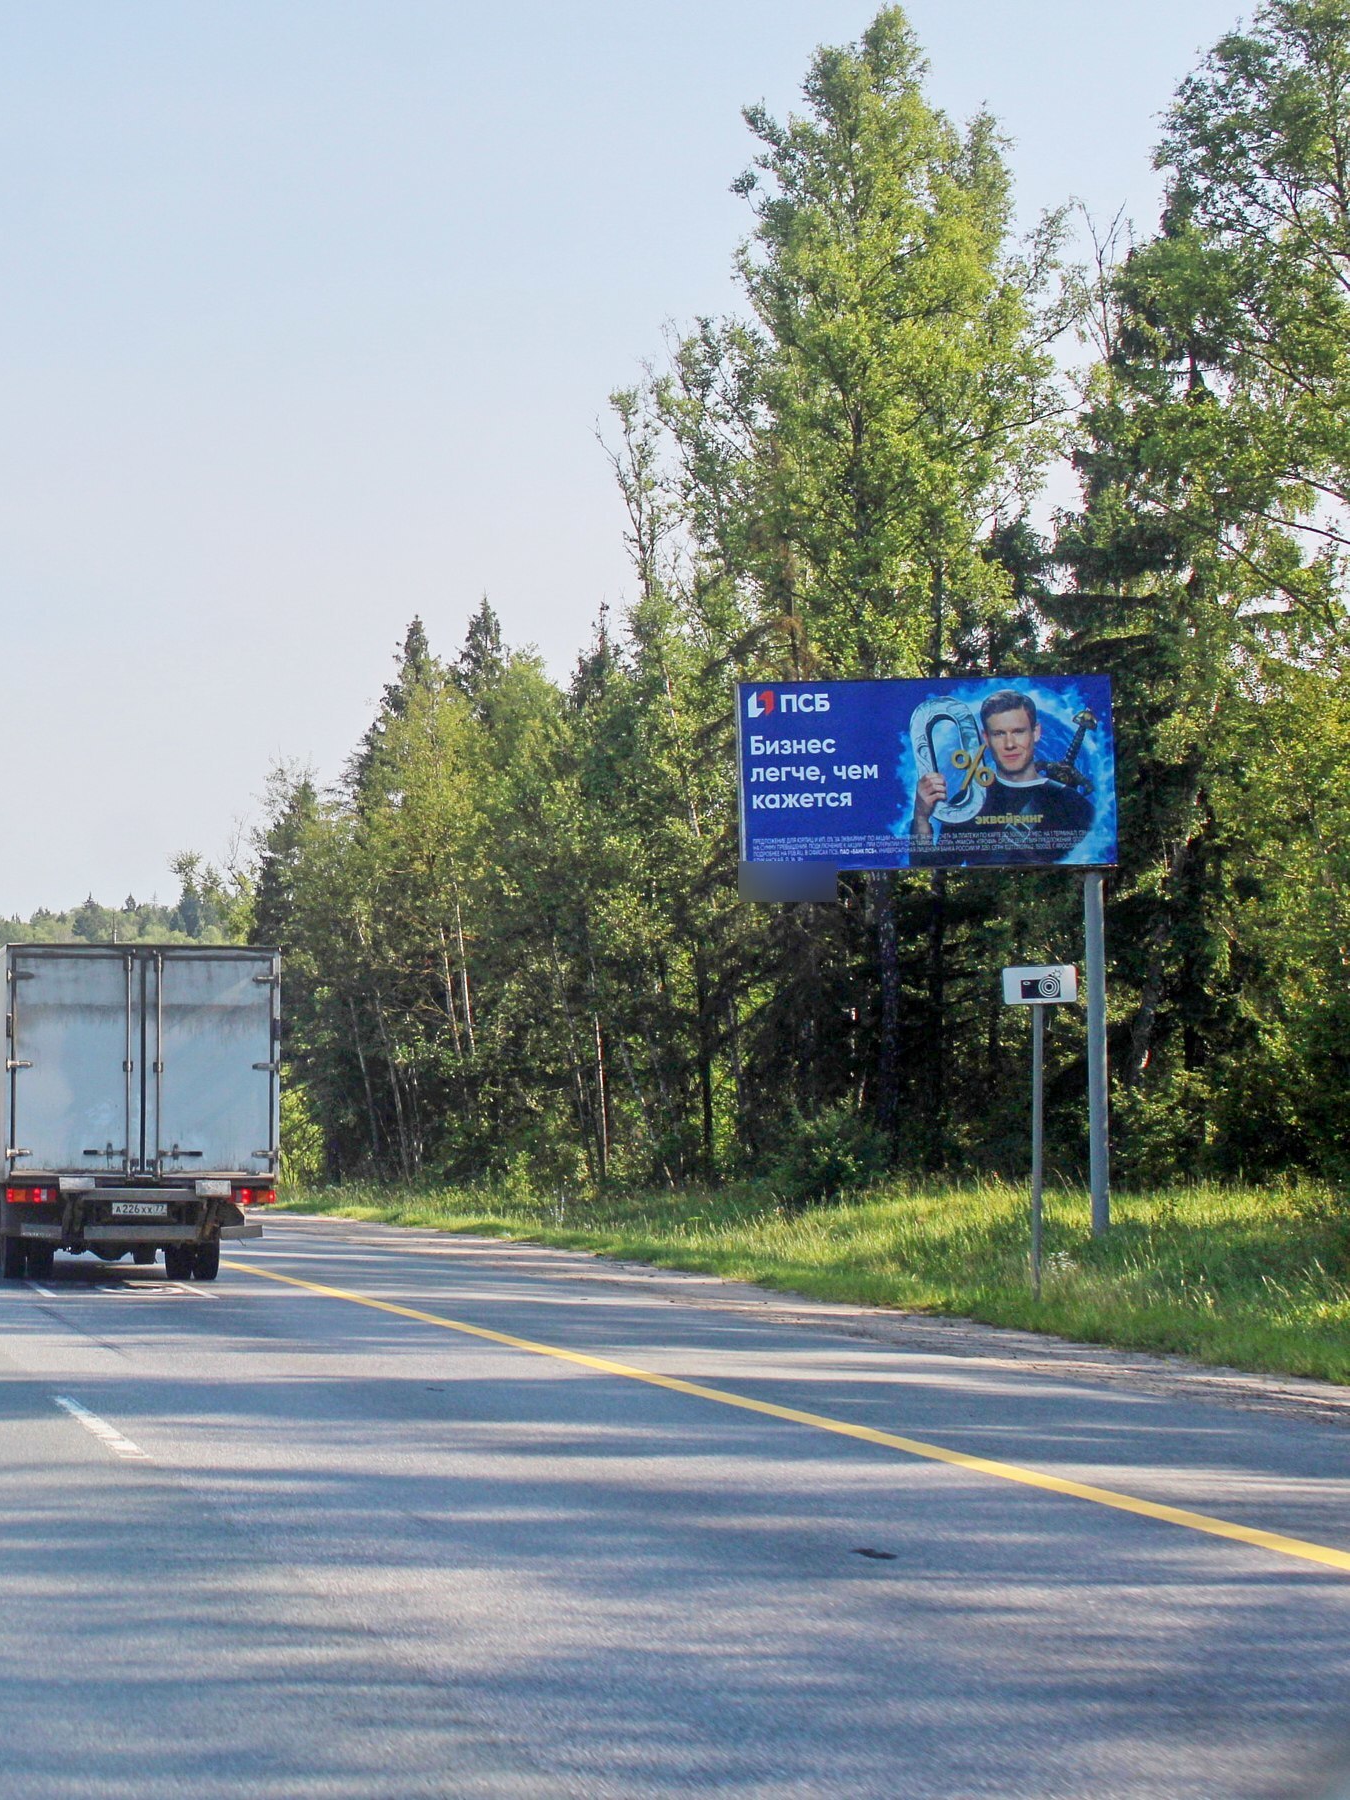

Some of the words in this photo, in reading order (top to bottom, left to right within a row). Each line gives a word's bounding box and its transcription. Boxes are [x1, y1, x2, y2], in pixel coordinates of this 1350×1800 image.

[780, 693, 831, 713] ПСБ
[750, 735, 837, 755] Бизнес
[750, 765, 826, 784] легче,
[833, 764, 879, 780] чем
[752, 792, 853, 810] кажется
